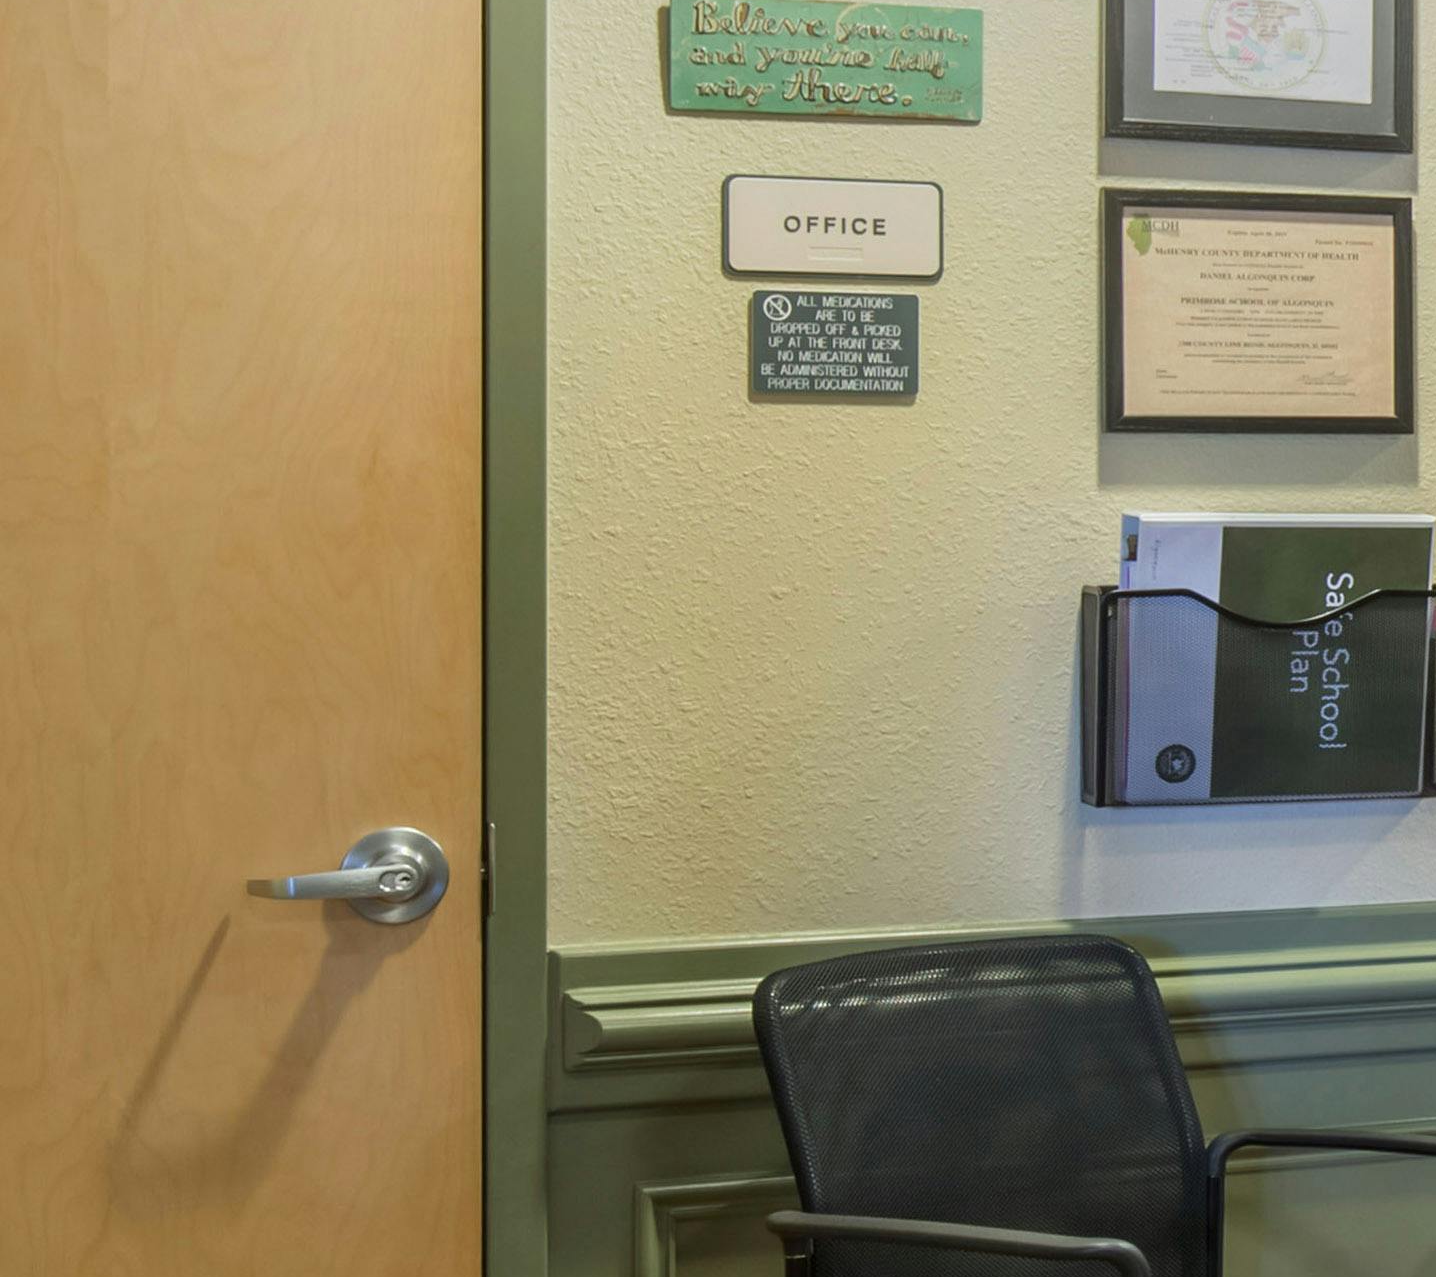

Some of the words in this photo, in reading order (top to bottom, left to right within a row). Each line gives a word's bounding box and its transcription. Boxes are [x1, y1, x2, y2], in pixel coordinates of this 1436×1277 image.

[690, 0, 830, 38] Believe
[836, 22, 896, 43] you
[688, 43, 745, 67] and
[755, 43, 875, 72] you're
[781, 69, 913, 105] there.
[783, 214, 888, 237] OFFICE
[1201, 248, 1240, 258] COUNTY
[1243, 249, 1304, 259] DEPARTMENT
[1307, 252, 1318, 260] OF
[1321, 252, 1359, 260] HEALTH
[796, 295, 817, 308] ALL
[822, 296, 893, 309] MEDICATIONS
[815, 310, 836, 321] ARE
[842, 310, 856, 321] TO
[860, 311, 875, 322] BE
[770, 323, 820, 335] DROPPED
[825, 324, 846, 335] OFF
[852, 325, 859, 336] &
[864, 325, 901, 337] PICKED
[768, 336, 784, 347] UP
[788, 336, 802, 348] AT
[808, 337, 828, 348] THE
[832, 337, 867, 349] FRONT
[778, 350, 794, 361] NO
[800, 350, 862, 363] MEDICATION
[867, 352, 892, 364] WILL
[761, 363, 775, 375] BE
[780, 363, 858, 377] ADMINISTERED
[863, 365, 909, 378] WITHOUT
[767, 377, 810, 389] PROPER
[814, 378, 904, 391] DOCUMENTATION
[1290, 630, 1319, 692] Plan
[1319, 648, 1350, 748] School
